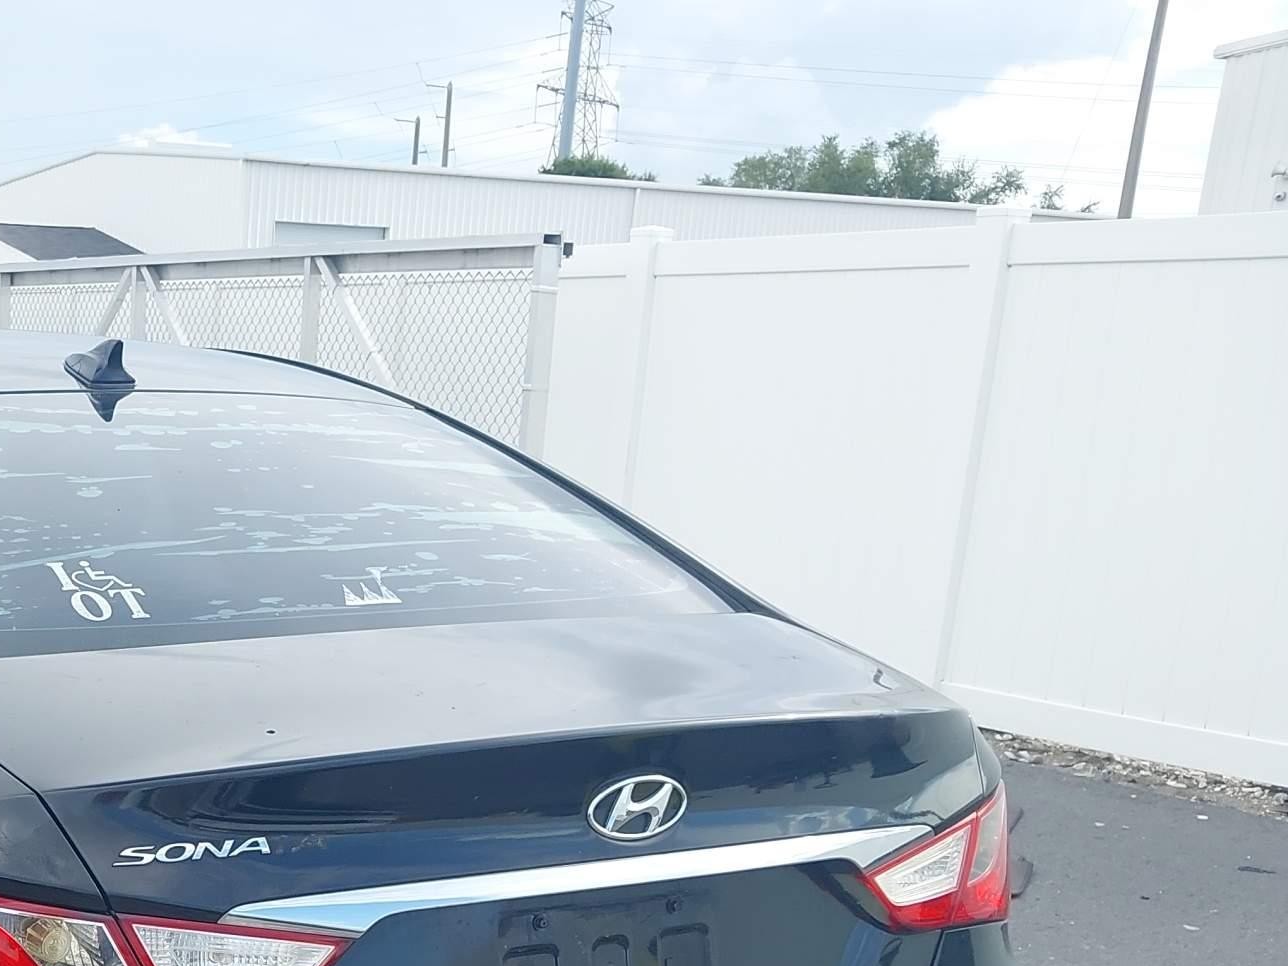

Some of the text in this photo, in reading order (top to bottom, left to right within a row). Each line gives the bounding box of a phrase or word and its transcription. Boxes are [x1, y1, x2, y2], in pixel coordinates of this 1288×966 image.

[46, 562, 81, 591] I
[70, 588, 152, 622] OT
[112, 836, 271, 867] SONA
